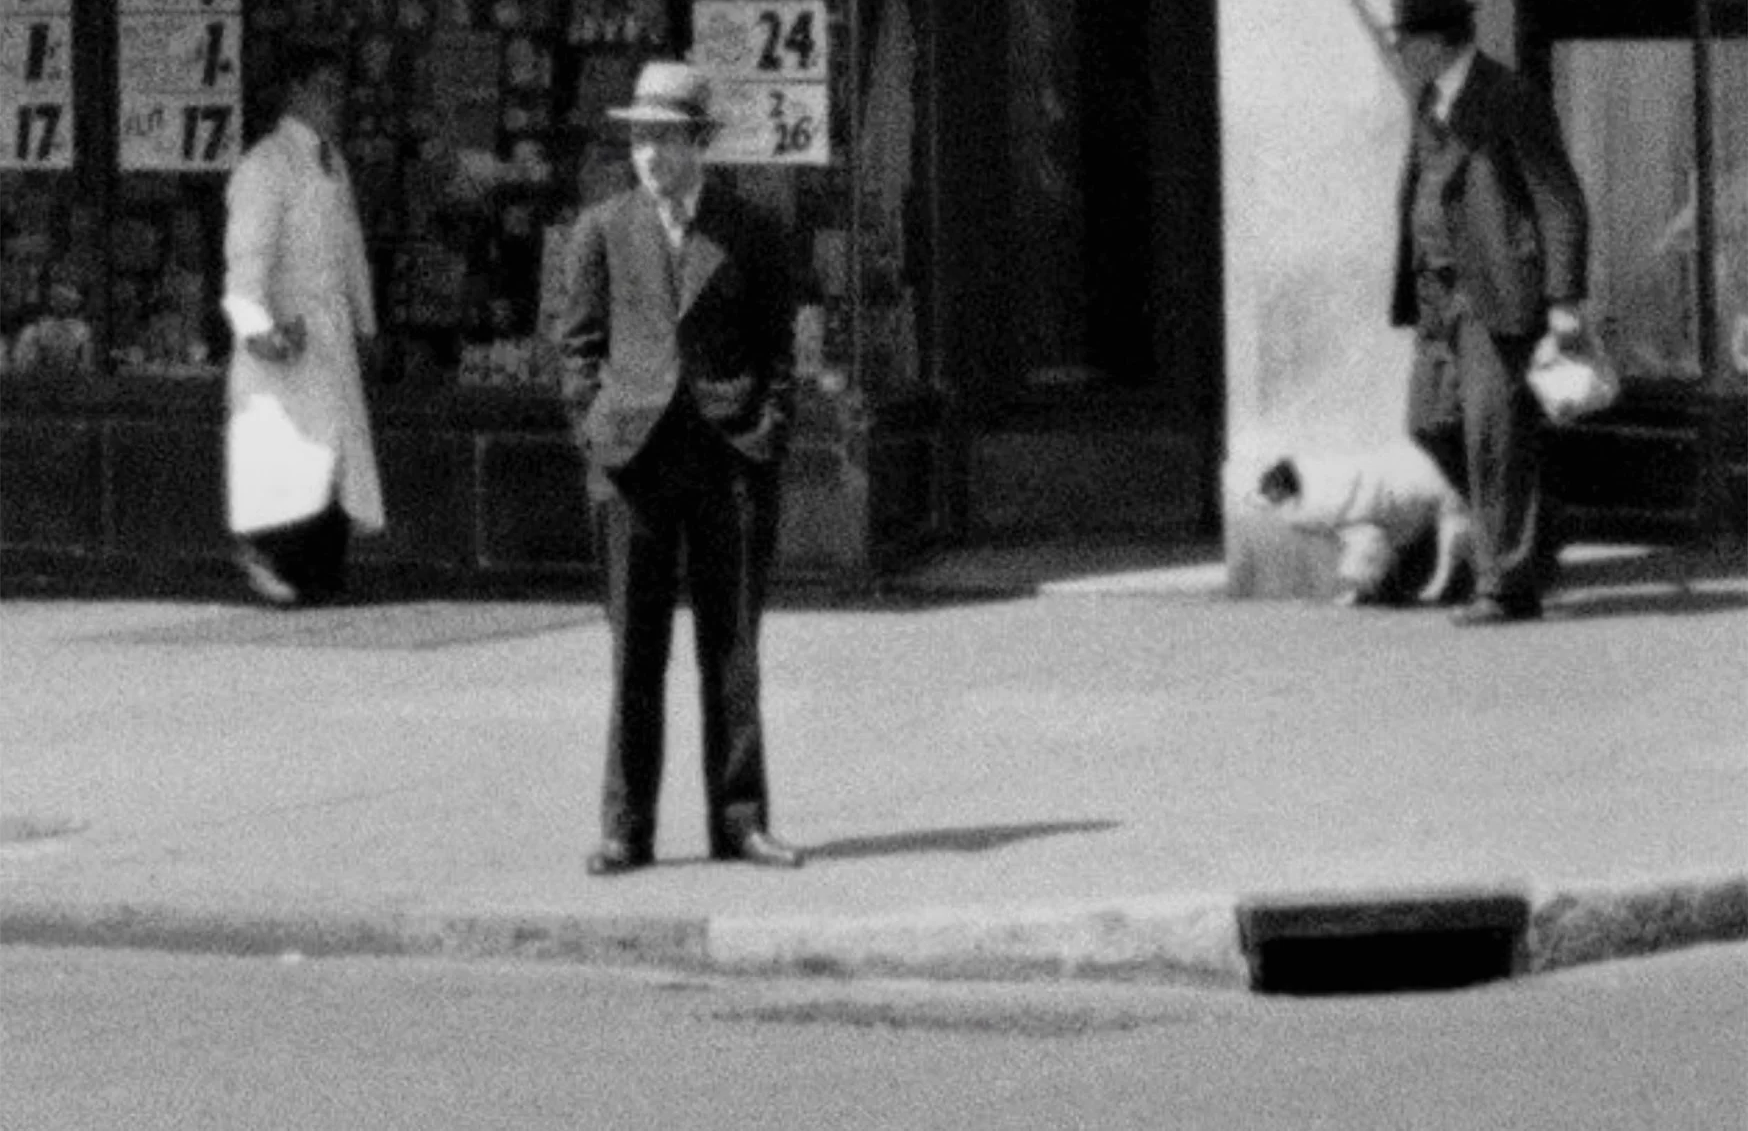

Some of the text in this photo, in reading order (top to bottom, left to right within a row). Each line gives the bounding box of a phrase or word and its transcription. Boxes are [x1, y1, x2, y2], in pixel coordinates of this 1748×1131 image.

[757, 10, 815, 71] 24
[16, 103, 62, 161] 17
[181, 103, 233, 161] 17
